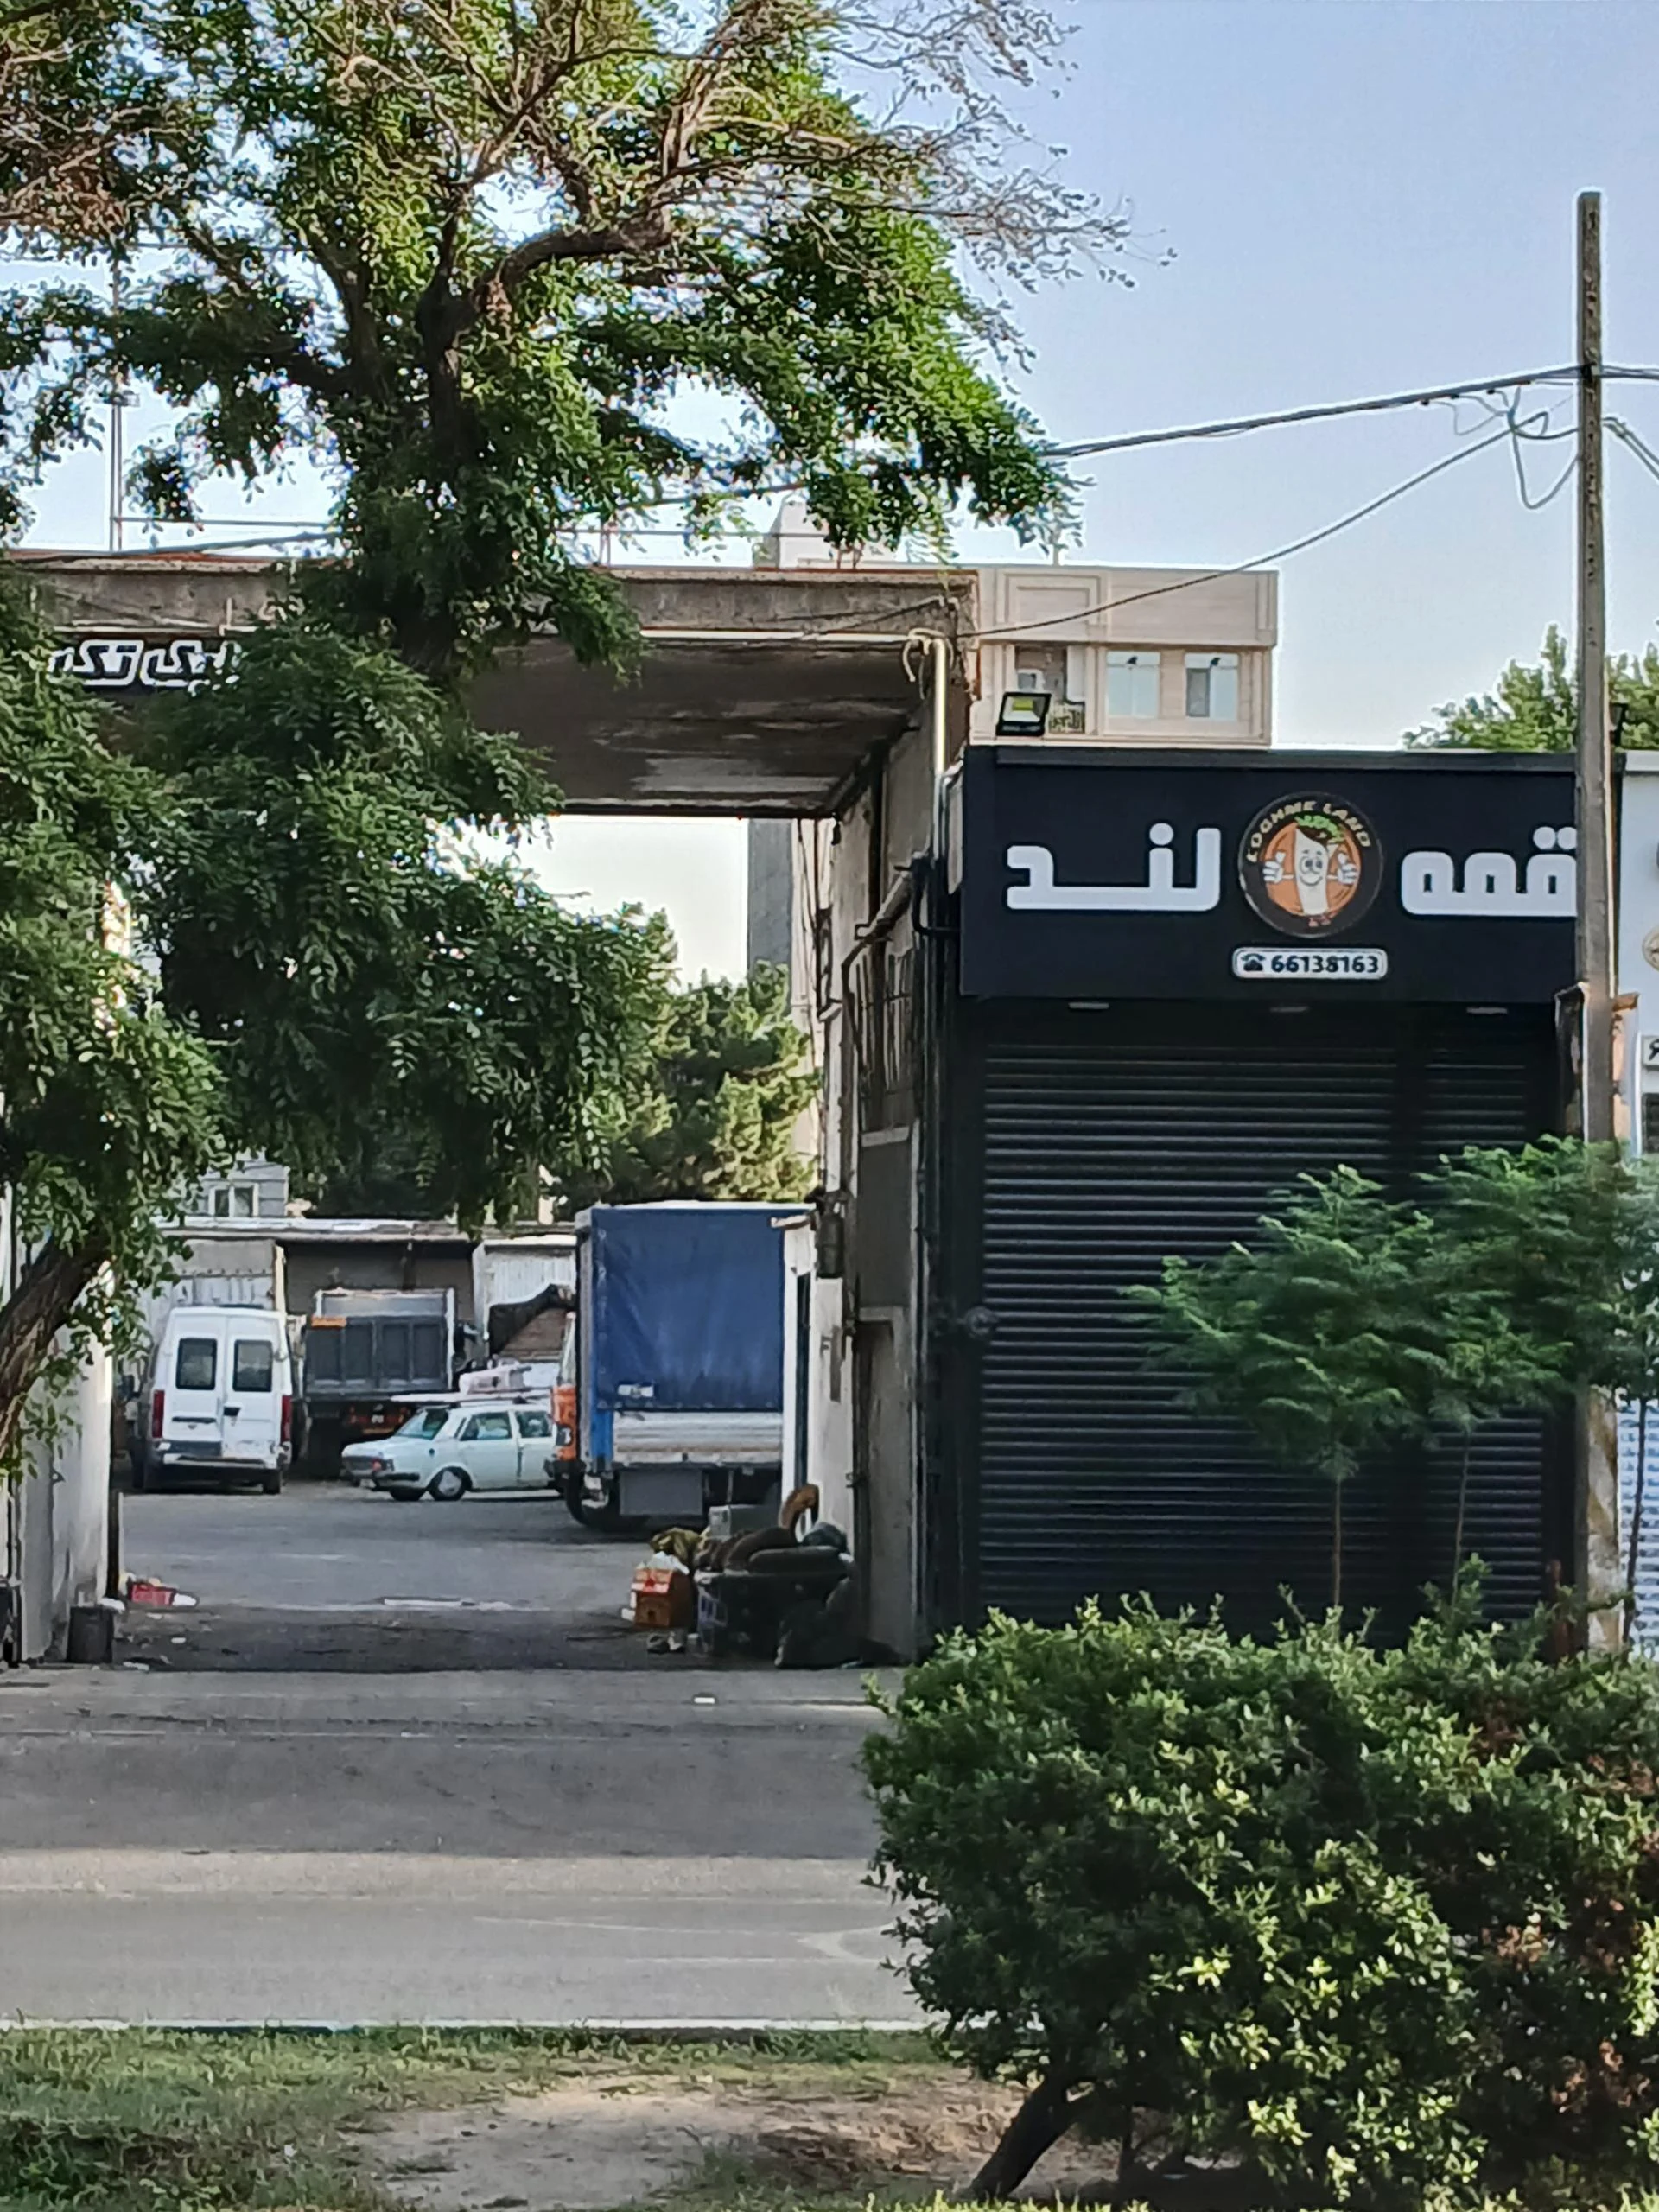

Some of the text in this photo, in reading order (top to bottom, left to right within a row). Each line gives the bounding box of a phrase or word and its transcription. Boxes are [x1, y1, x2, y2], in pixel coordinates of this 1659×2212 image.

[1323, 803, 1371, 847] LAND
[1007, 822, 1577, 917] قمه لند
[1271, 955, 1379, 974] 66138163
